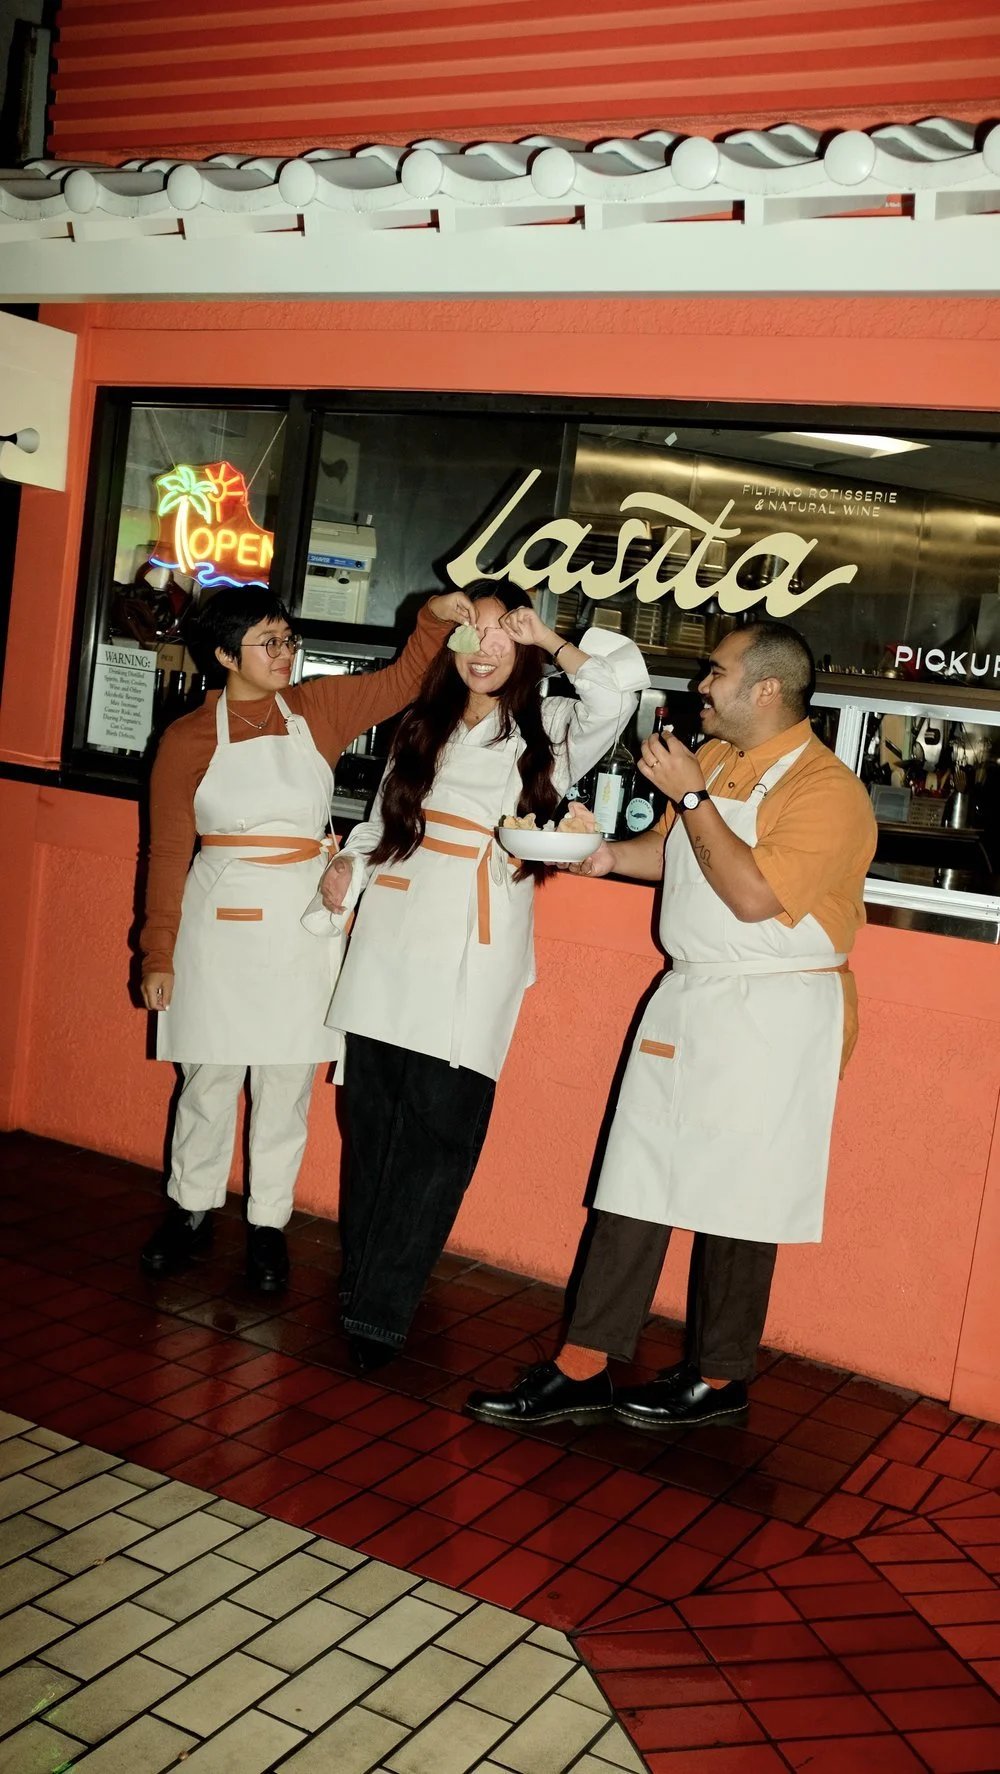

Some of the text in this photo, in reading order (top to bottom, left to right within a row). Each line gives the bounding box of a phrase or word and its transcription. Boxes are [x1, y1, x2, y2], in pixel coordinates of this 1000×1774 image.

[742, 484, 898, 503] FILIPINO ROTISSERIE
[754, 499, 881, 518] & NATURAL WINE
[105, 650, 151, 668] WARNING:
[103, 714, 118, 722] During
